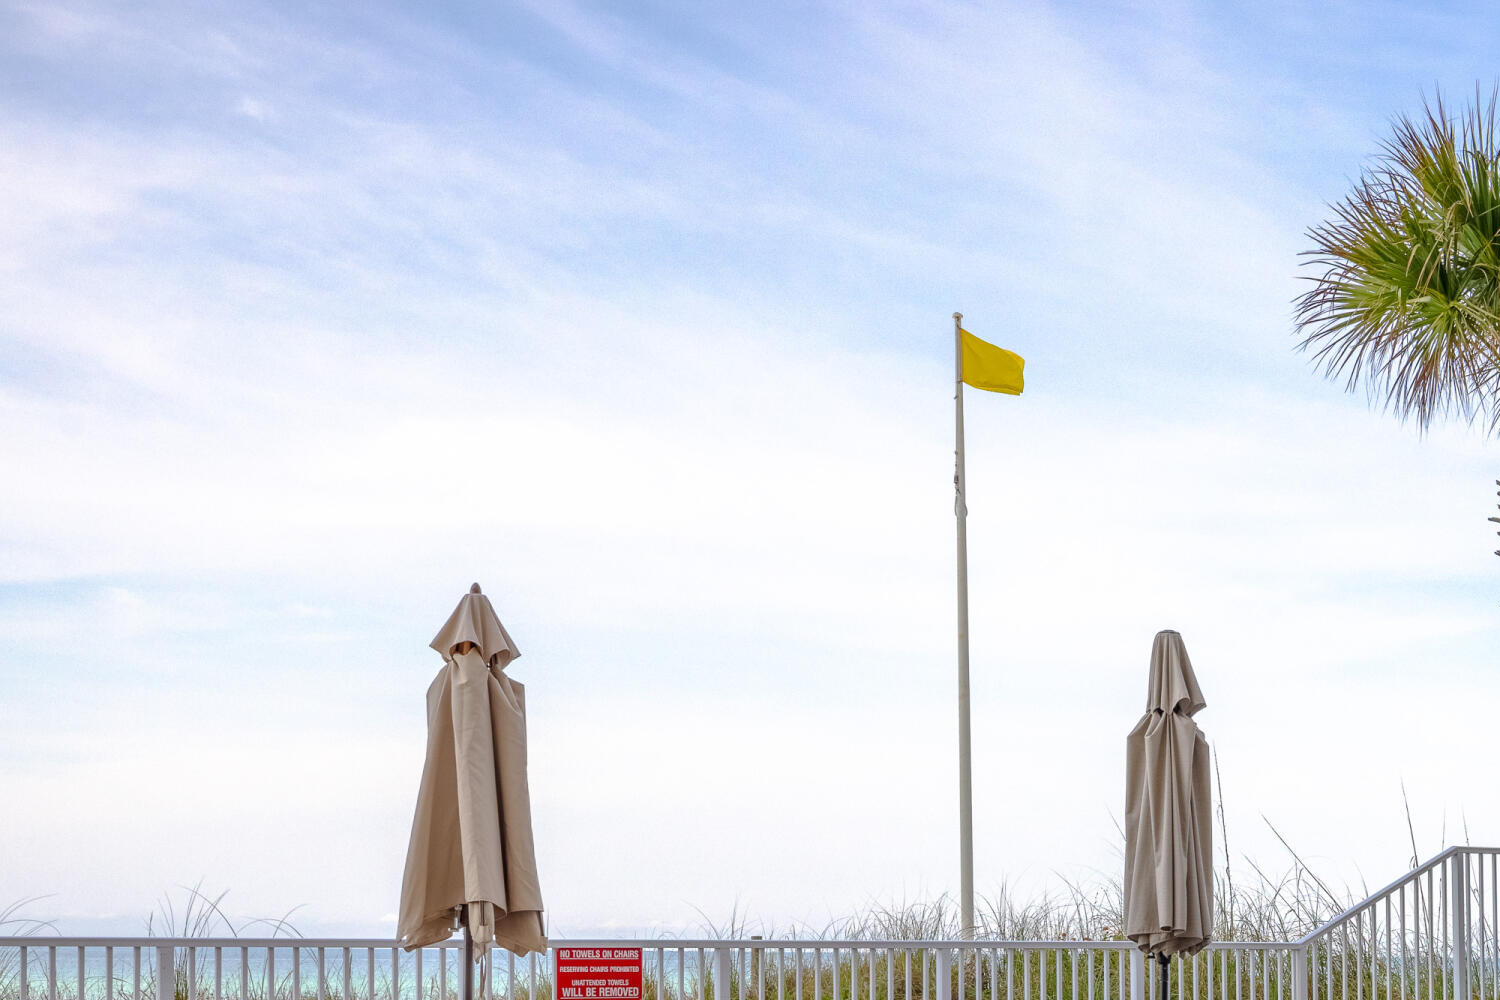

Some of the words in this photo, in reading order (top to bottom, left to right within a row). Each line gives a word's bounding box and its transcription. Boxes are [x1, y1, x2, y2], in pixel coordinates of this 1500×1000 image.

[560, 950, 570, 958] NO
[572, 950, 600, 958] TOWELS
[602, 950, 612, 958] ON
[614, 950, 639, 958] CHAIRS
[562, 987, 583, 997] WILL
[586, 987, 596, 996] BE
[599, 987, 639, 996] REMOVED
